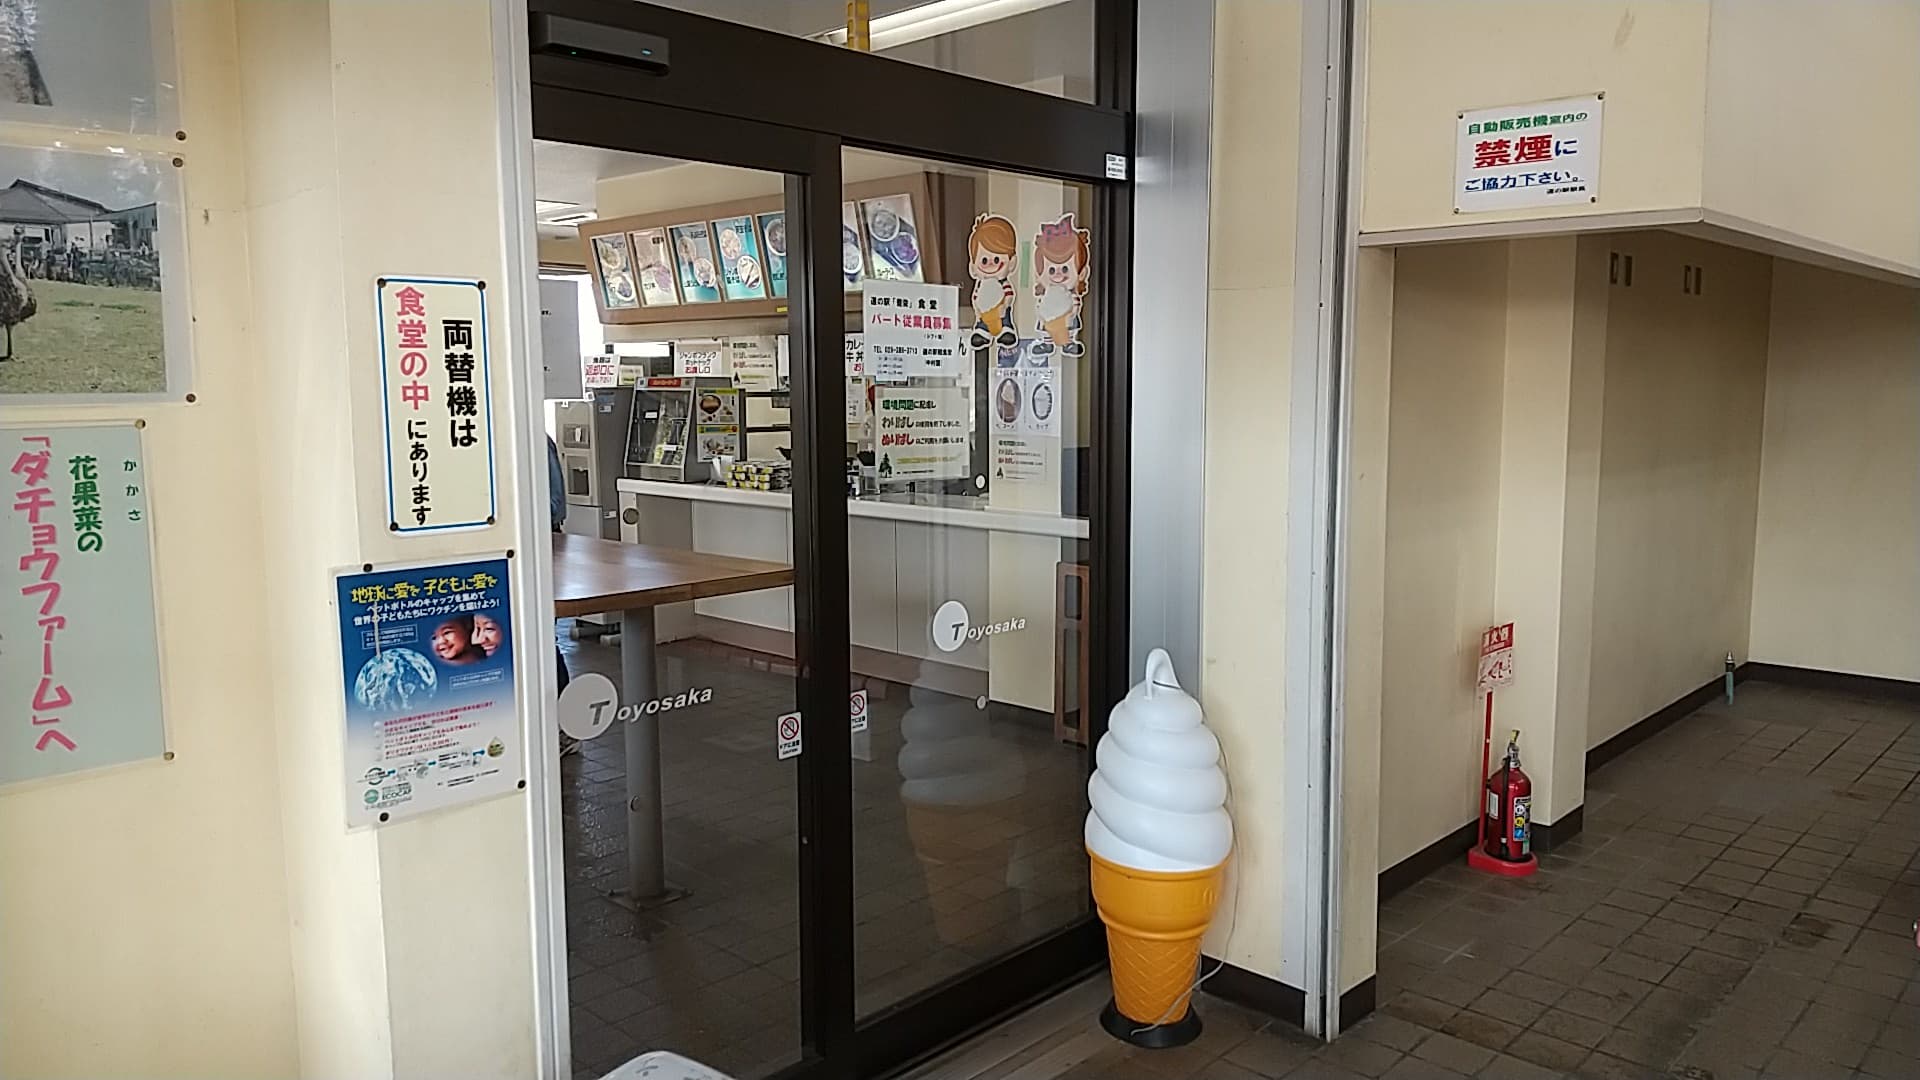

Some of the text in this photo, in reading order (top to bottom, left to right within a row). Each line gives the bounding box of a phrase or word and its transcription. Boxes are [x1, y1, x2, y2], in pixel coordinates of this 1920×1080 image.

[1468, 112, 1588, 135] 自動販売機室内の
[1474, 134, 1578, 168] 禁煙に
[1465, 171, 1579, 191] ご協力下さい。
[871, 313, 952, 329] パート従業員募集
[442, 319, 478, 447] 両替機は
[69, 455, 104, 553] 花果菜の
[10, 436, 78, 752] 「ダチョウファーム」へ
[952, 617, 1026, 641] Toyosaka
[589, 686, 714, 726] Toyosaka
